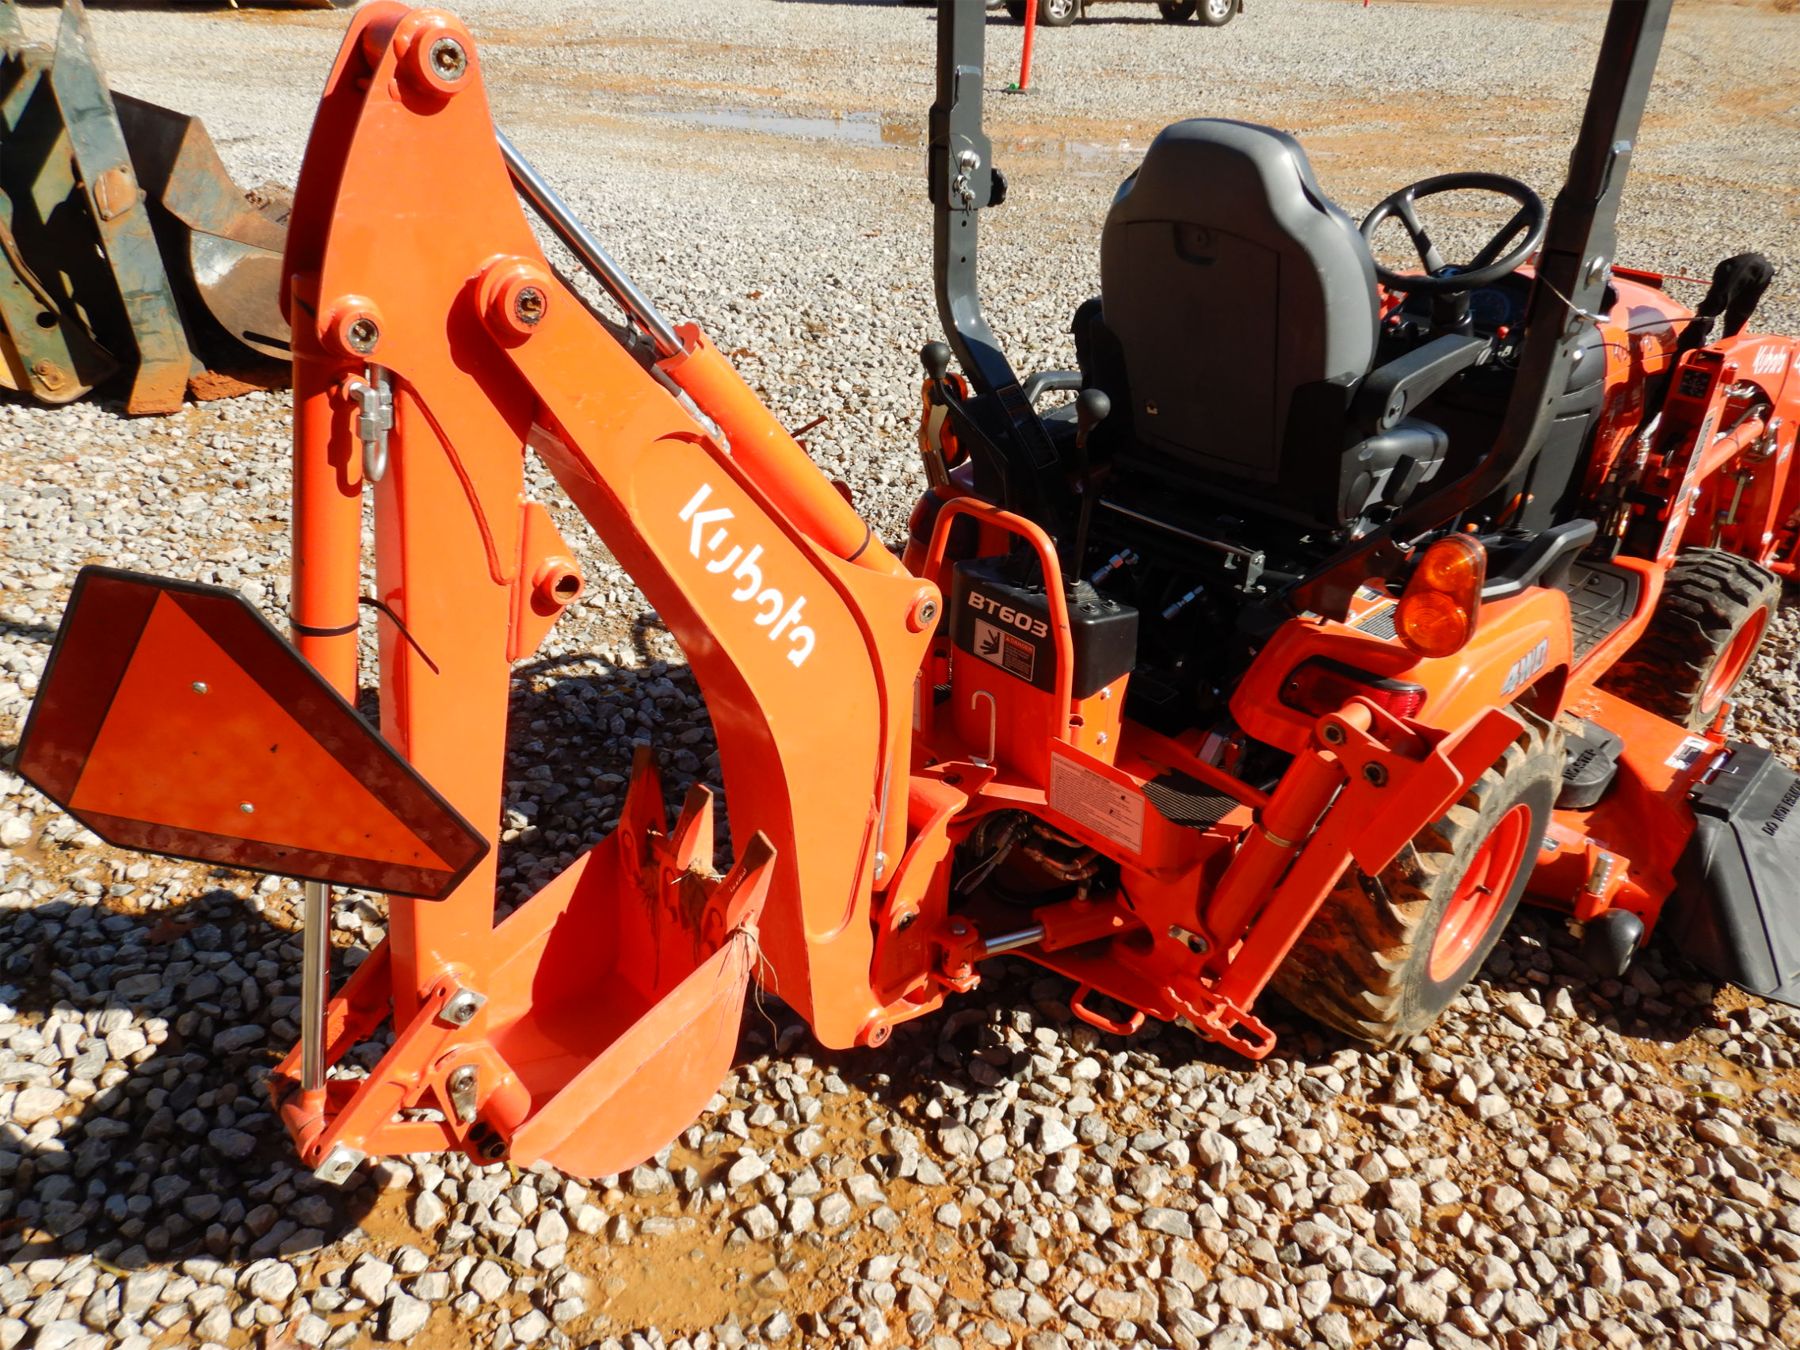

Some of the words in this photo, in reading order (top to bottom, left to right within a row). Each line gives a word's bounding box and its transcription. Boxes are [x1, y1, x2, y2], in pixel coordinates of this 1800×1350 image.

[678, 483, 816, 668] Kubota
[968, 591, 1049, 638] BT603
[1500, 637, 1548, 697] 4WD
[1761, 821, 1779, 837] DO
[1771, 804, 1791, 823] NOT
